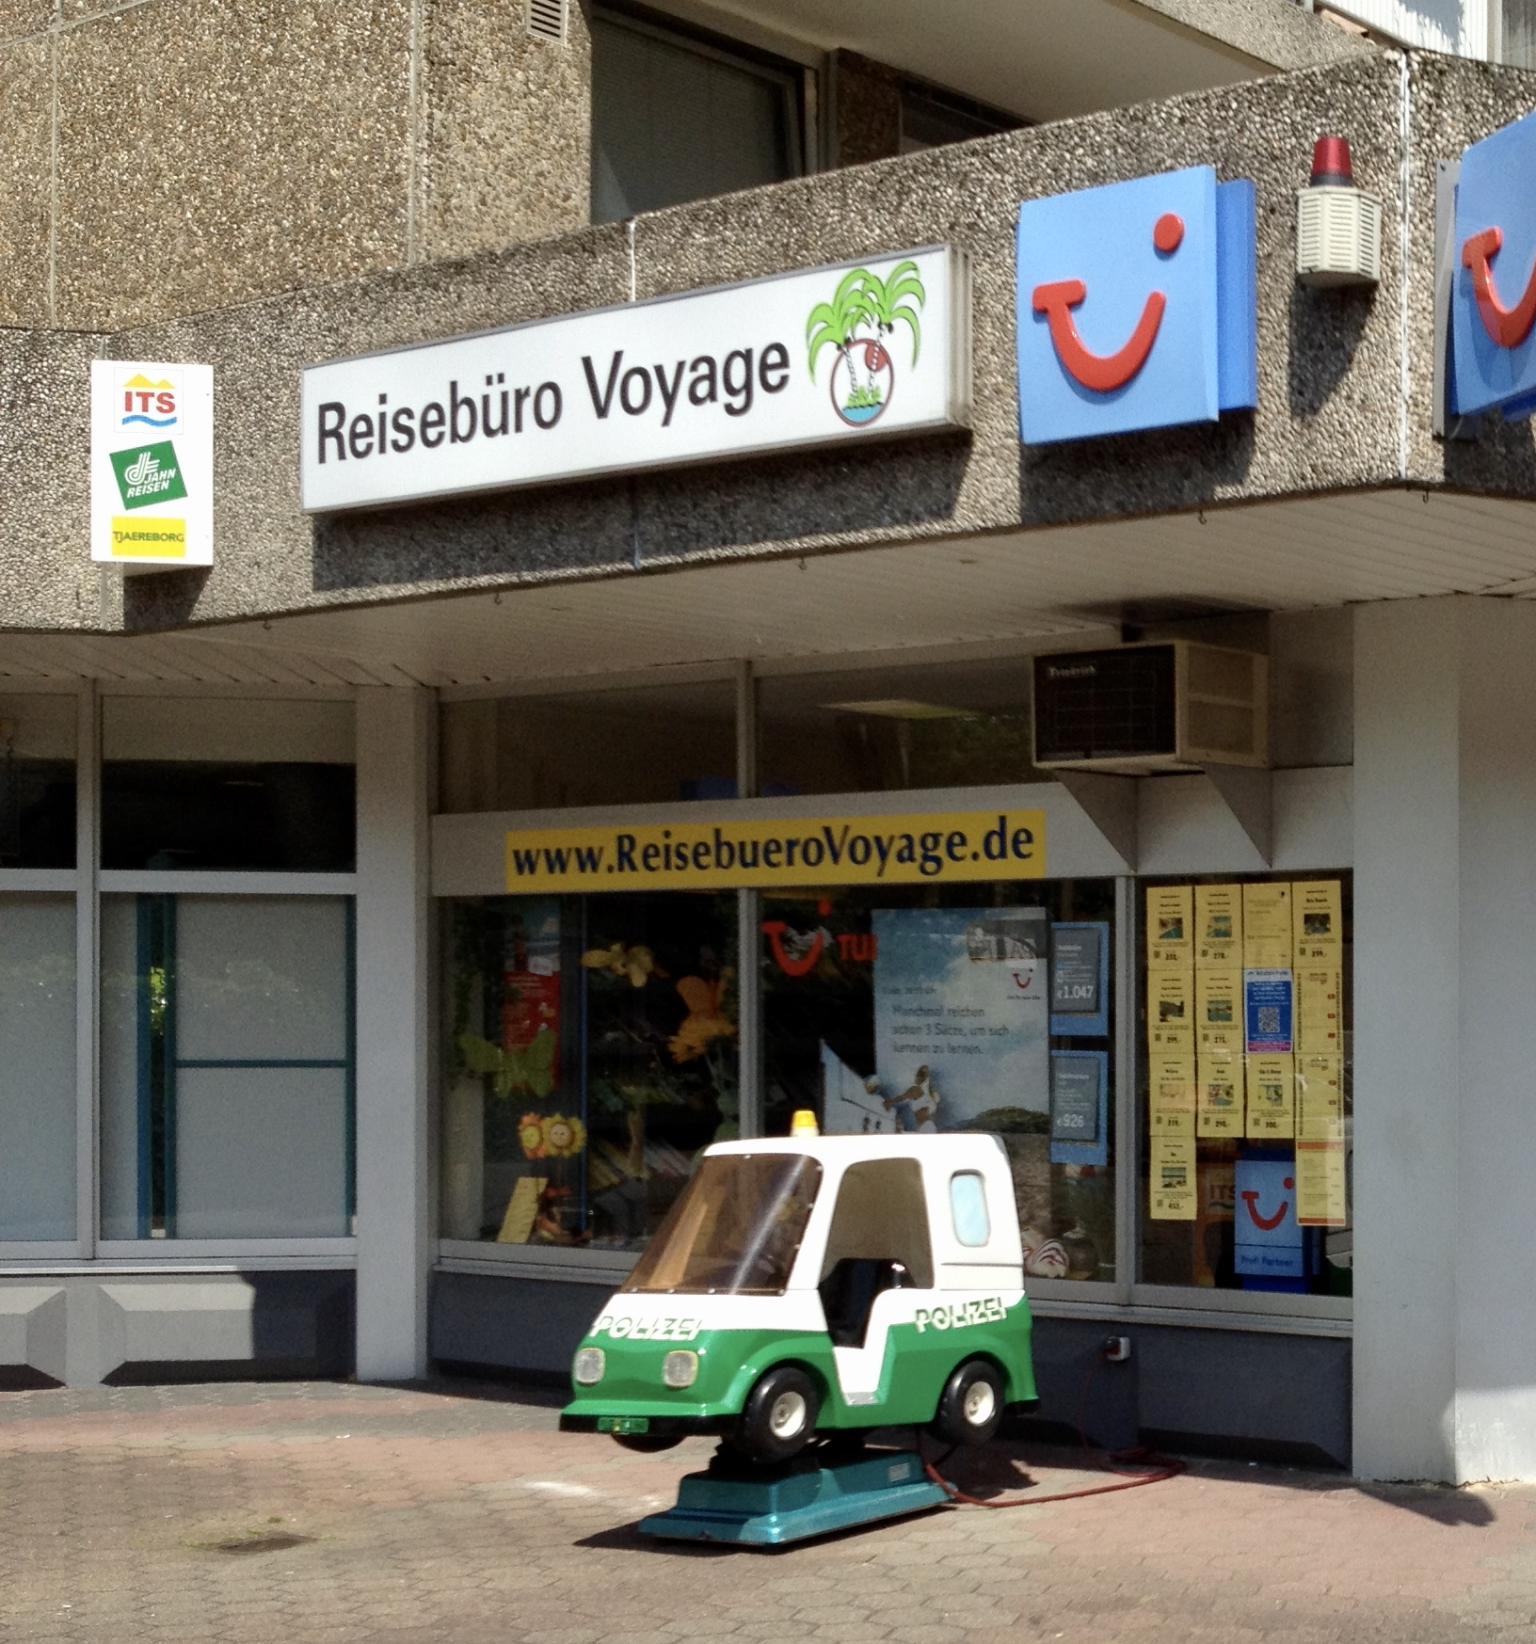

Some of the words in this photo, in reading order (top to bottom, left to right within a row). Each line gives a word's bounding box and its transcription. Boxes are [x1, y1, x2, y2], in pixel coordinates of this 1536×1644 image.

[124, 391, 176, 414] ITS
[318, 371, 563, 464] Reisebüro
[581, 341, 790, 427] Voyage
[144, 467, 177, 484] JAHN
[126, 479, 170, 499] REISEN
[113, 530, 185, 544] TJAEREBORG
[512, 815, 1034, 877] www.ReisebueroVoyage.de
[835, 932, 878, 961] TUI
[589, 1315, 704, 1341] POLIZEI
[913, 1296, 1008, 1334] POLIZEI
